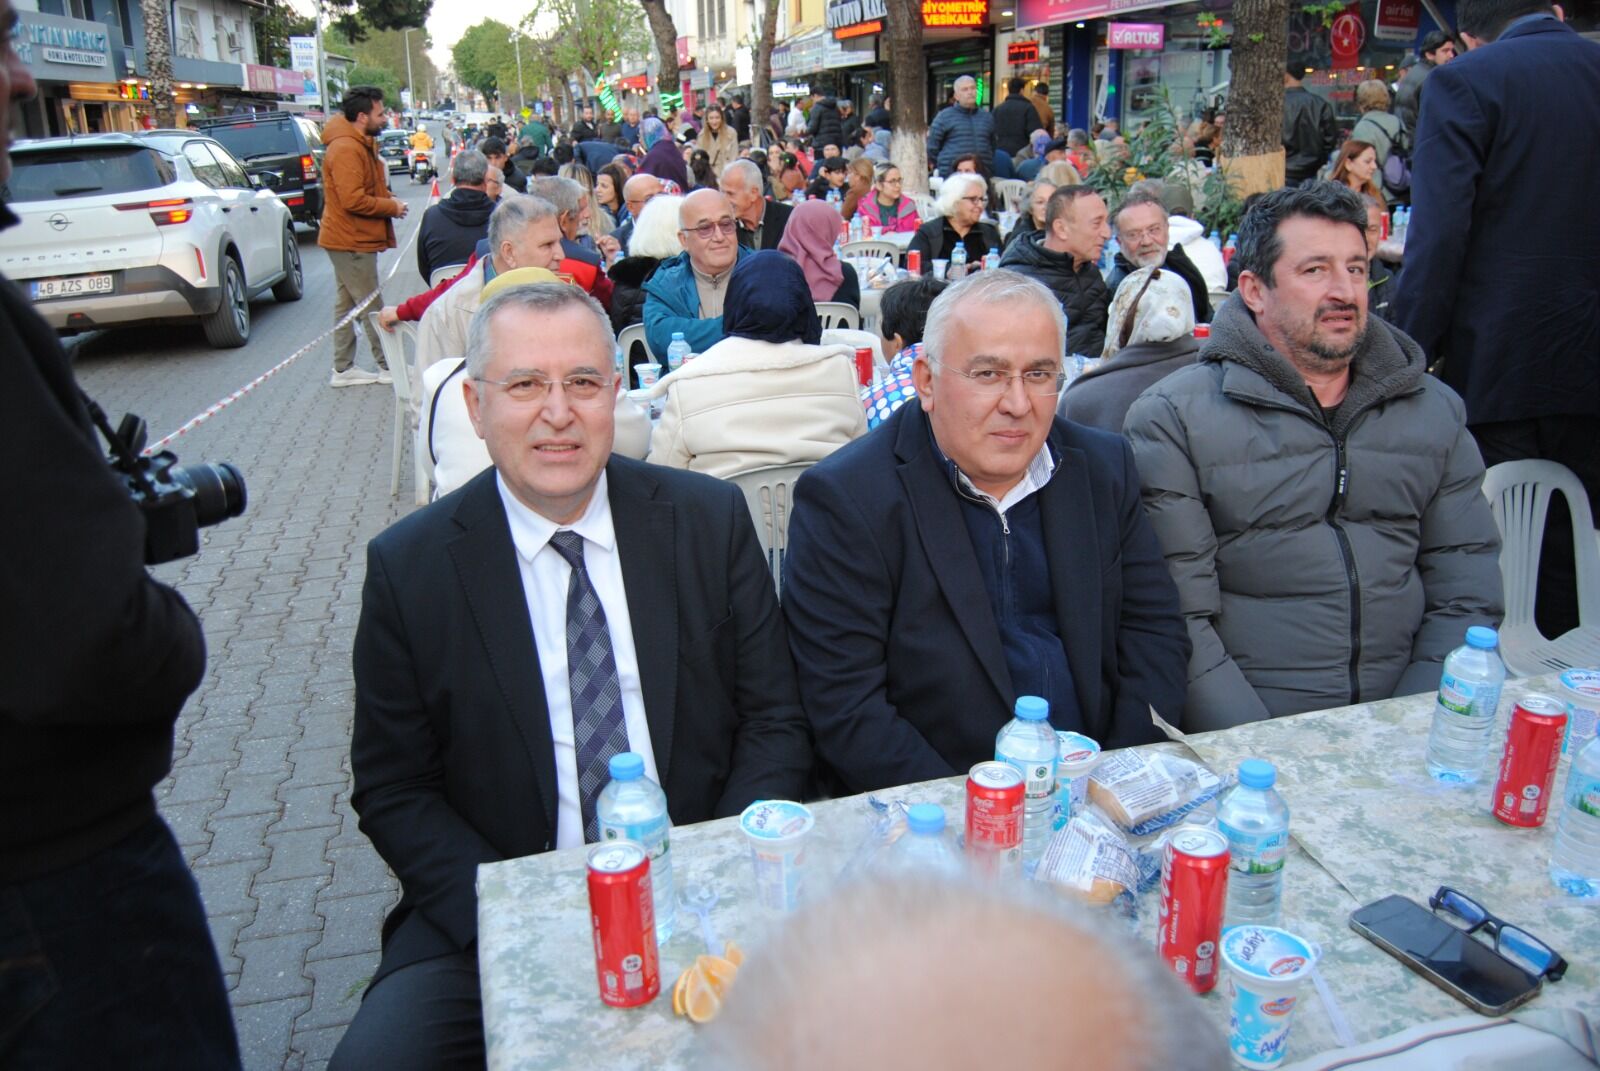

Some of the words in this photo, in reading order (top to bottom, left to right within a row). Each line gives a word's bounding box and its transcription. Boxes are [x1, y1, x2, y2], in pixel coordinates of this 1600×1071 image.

[924, 13, 982, 26] VESİKALIK
[1125, 31, 1160, 45] ALTUS
[68, 53, 84, 63] HOTEL
[60, 279, 82, 293] AZS
[88, 276, 111, 290] 089
